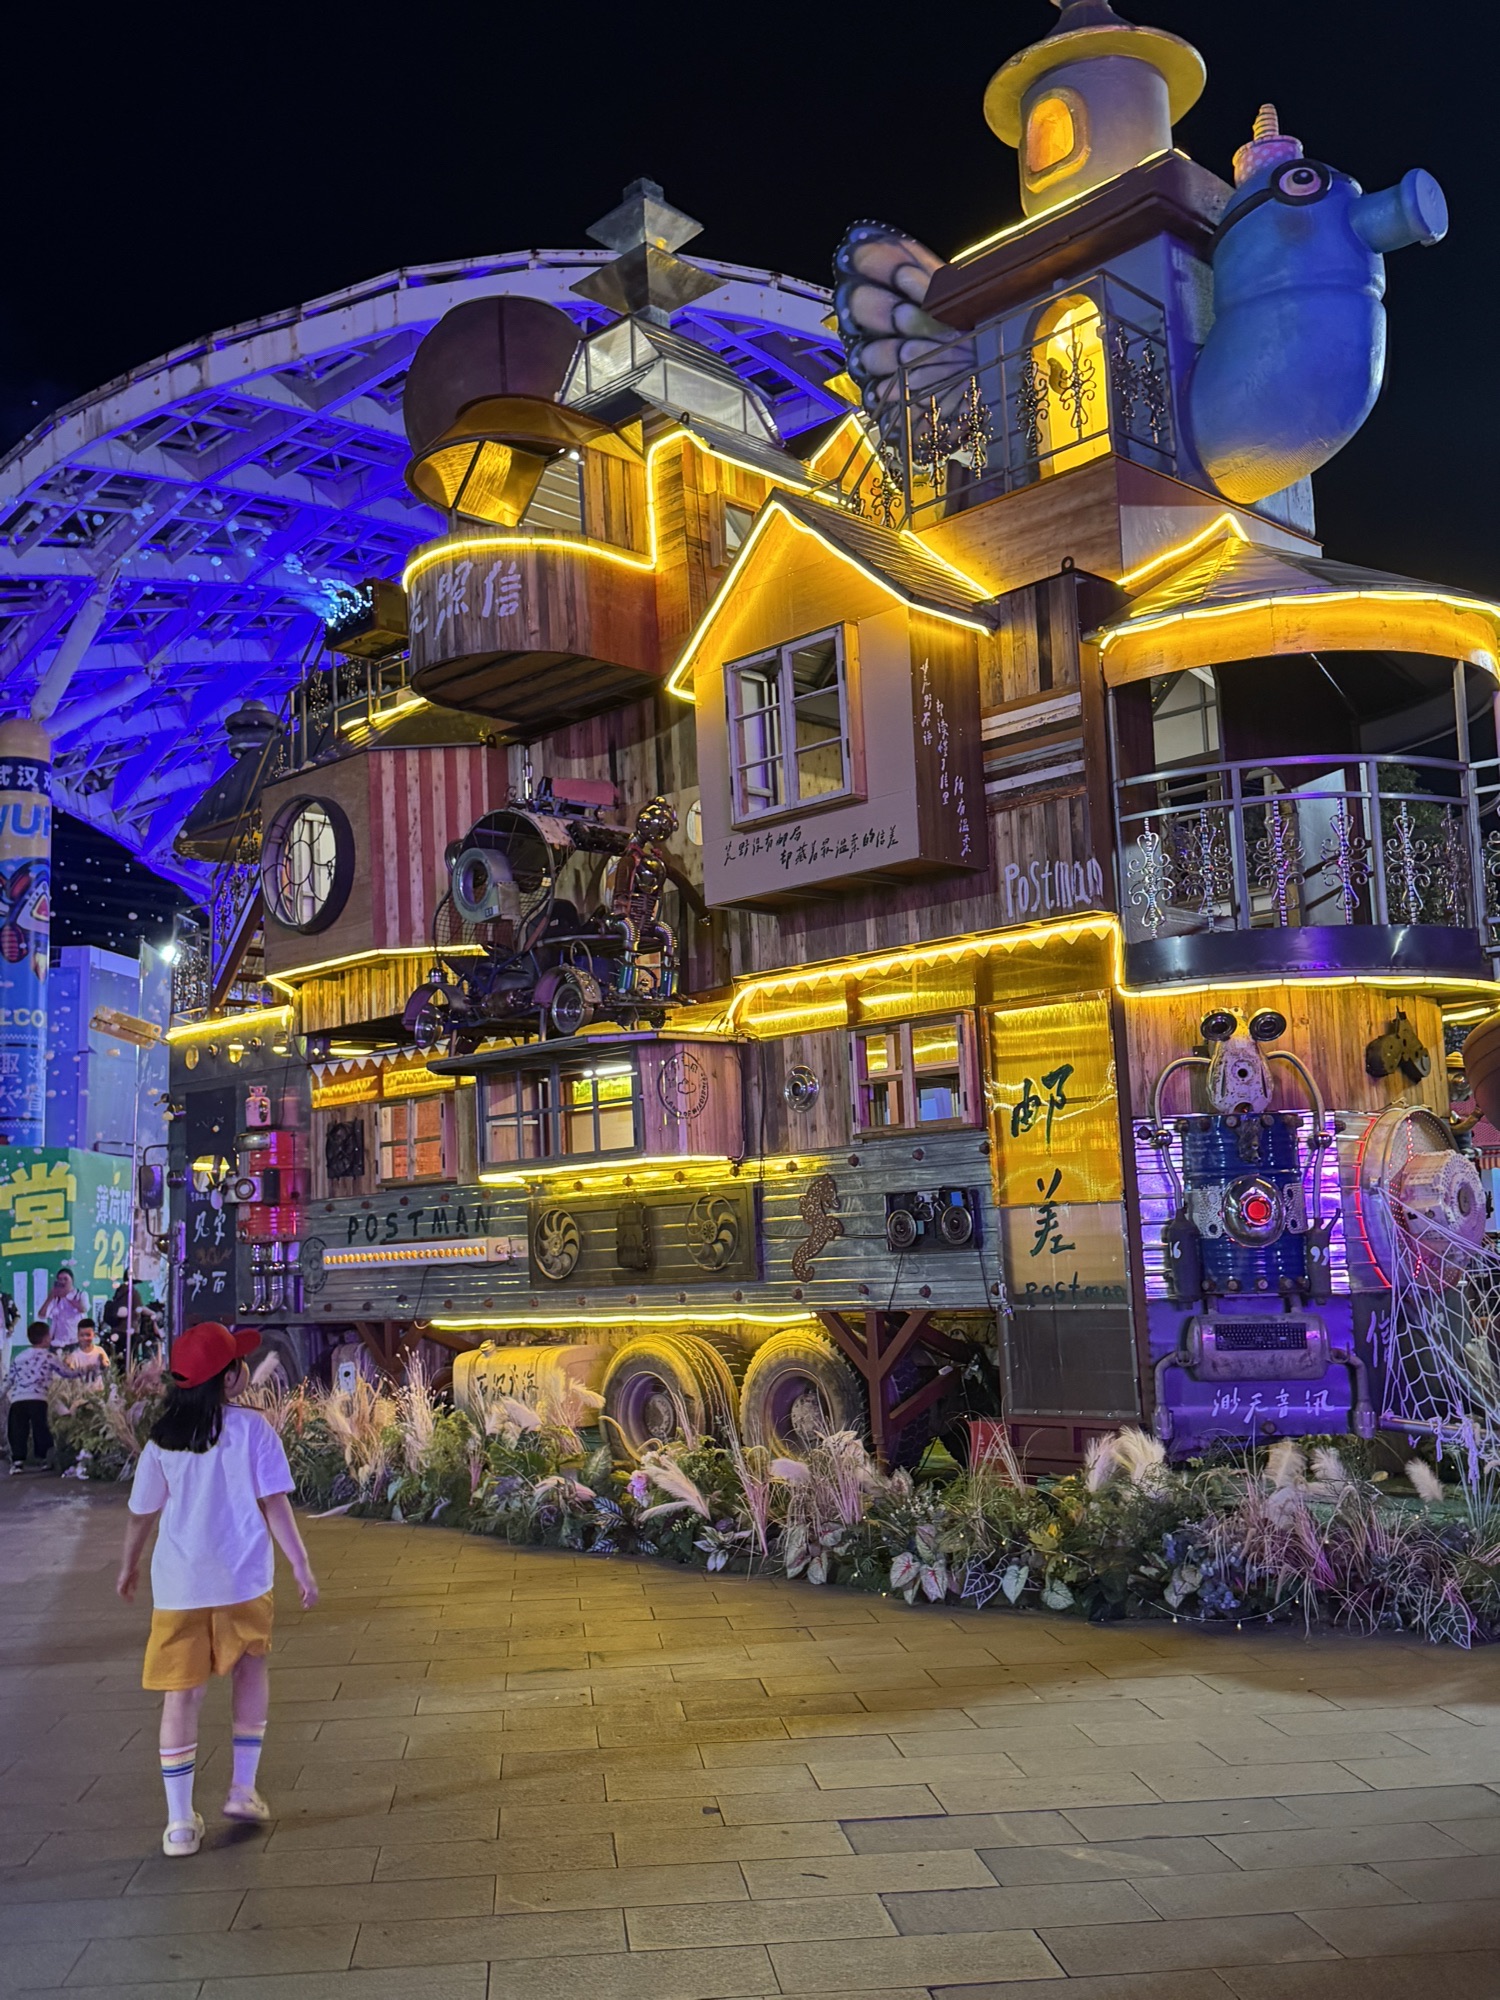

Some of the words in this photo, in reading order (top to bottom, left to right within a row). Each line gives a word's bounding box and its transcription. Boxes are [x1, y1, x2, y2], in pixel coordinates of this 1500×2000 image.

[1010, 1063, 1076, 1258] 邮差
[0, 1161, 77, 1257] 堂
[347, 1205, 492, 1245] POSTMAN
